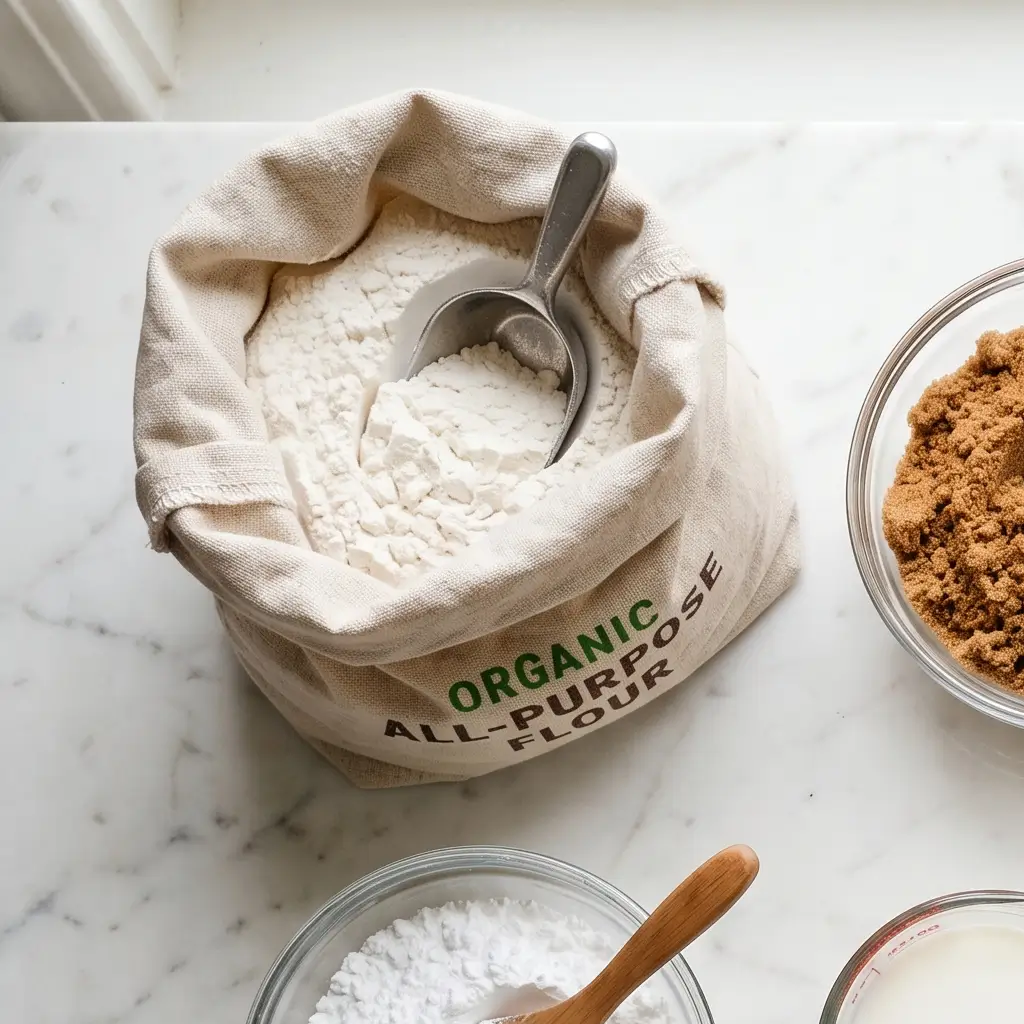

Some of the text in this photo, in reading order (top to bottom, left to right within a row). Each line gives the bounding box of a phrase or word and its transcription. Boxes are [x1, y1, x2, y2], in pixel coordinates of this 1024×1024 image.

[384, 551, 723, 743] ALL-PURPOSE
[448, 599, 659, 713] ORGANIC
[507, 658, 674, 752] FLOUR
